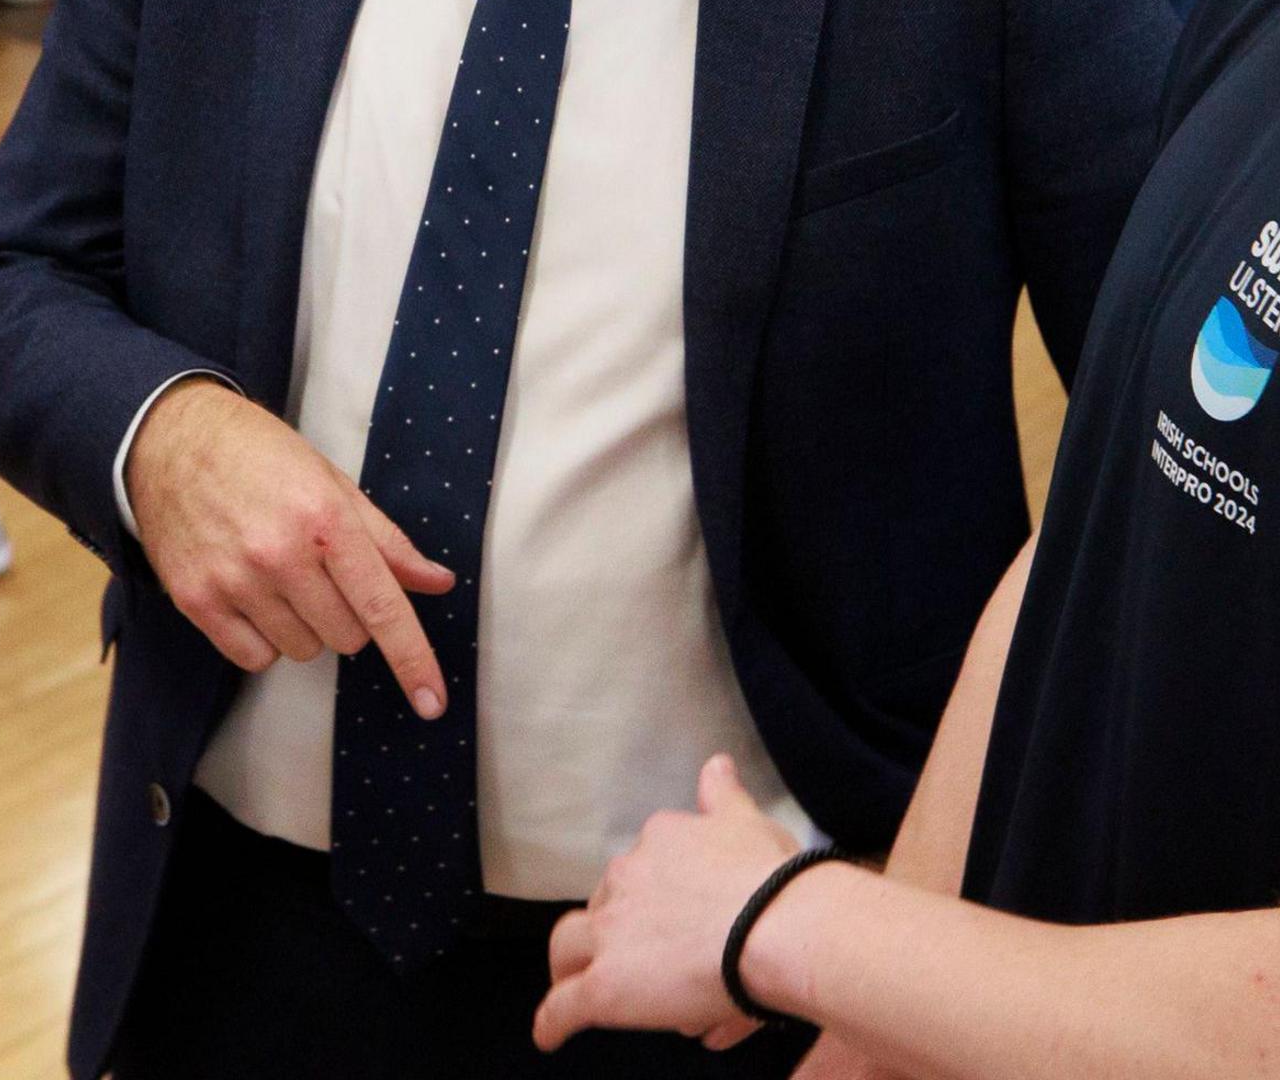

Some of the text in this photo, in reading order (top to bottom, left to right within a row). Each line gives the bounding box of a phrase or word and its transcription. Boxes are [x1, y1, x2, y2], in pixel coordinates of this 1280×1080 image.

[1151, 439, 1256, 534] INTERPRO 2024
[1157, 409, 1259, 506] IRISH SCHOOLS
